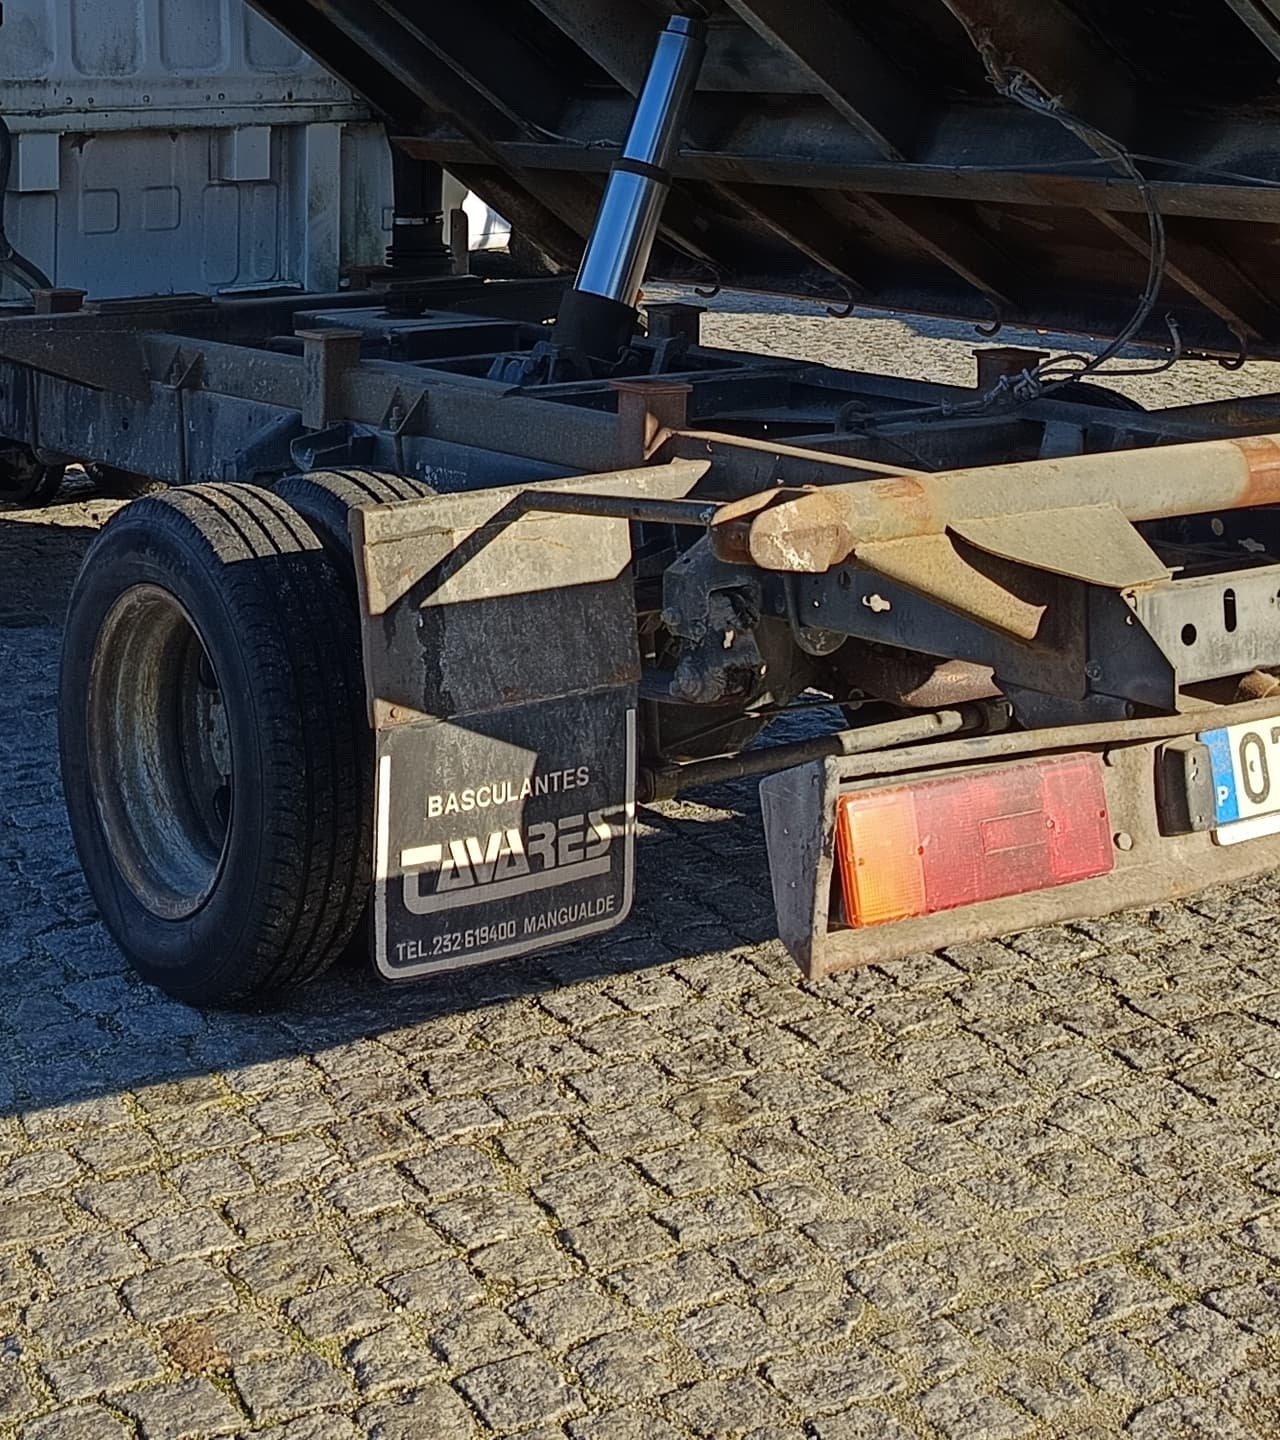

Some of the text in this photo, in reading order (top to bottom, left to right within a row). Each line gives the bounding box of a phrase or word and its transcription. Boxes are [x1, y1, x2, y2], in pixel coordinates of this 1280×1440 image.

[426, 766, 590, 819] BASCULANTES
[1216, 784, 1230, 808] P
[400, 806, 624, 915] TAVARES
[523, 894, 616, 935] MANGUALDE
